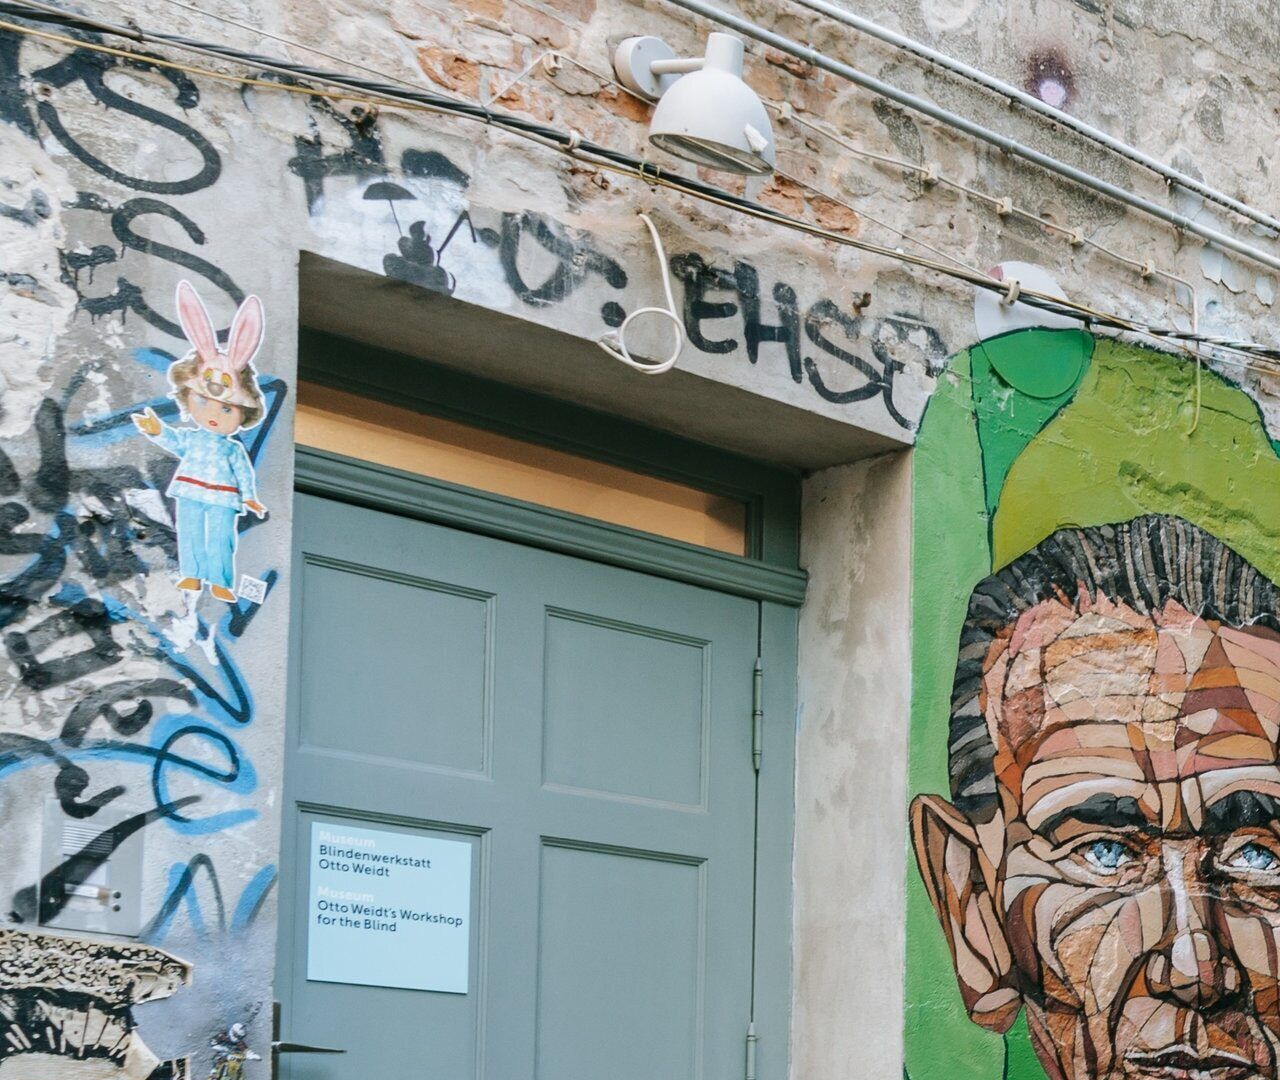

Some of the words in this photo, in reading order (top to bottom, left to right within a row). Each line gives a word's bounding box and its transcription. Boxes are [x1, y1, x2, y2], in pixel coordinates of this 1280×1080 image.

[319, 831, 376, 848] Museum
[319, 845, 432, 869] Blindenwerkstatt
[319, 859, 350, 872] Otto
[352, 863, 390, 877] Weidt
[317, 886, 374, 902] Museum
[318, 900, 349, 913] Otto
[351, 904, 397, 919] Weidt's
[400, 909, 463, 927] Workshop
[317, 914, 336, 925] for
[340, 917, 361, 929] the
[364, 919, 397, 932] Blind
